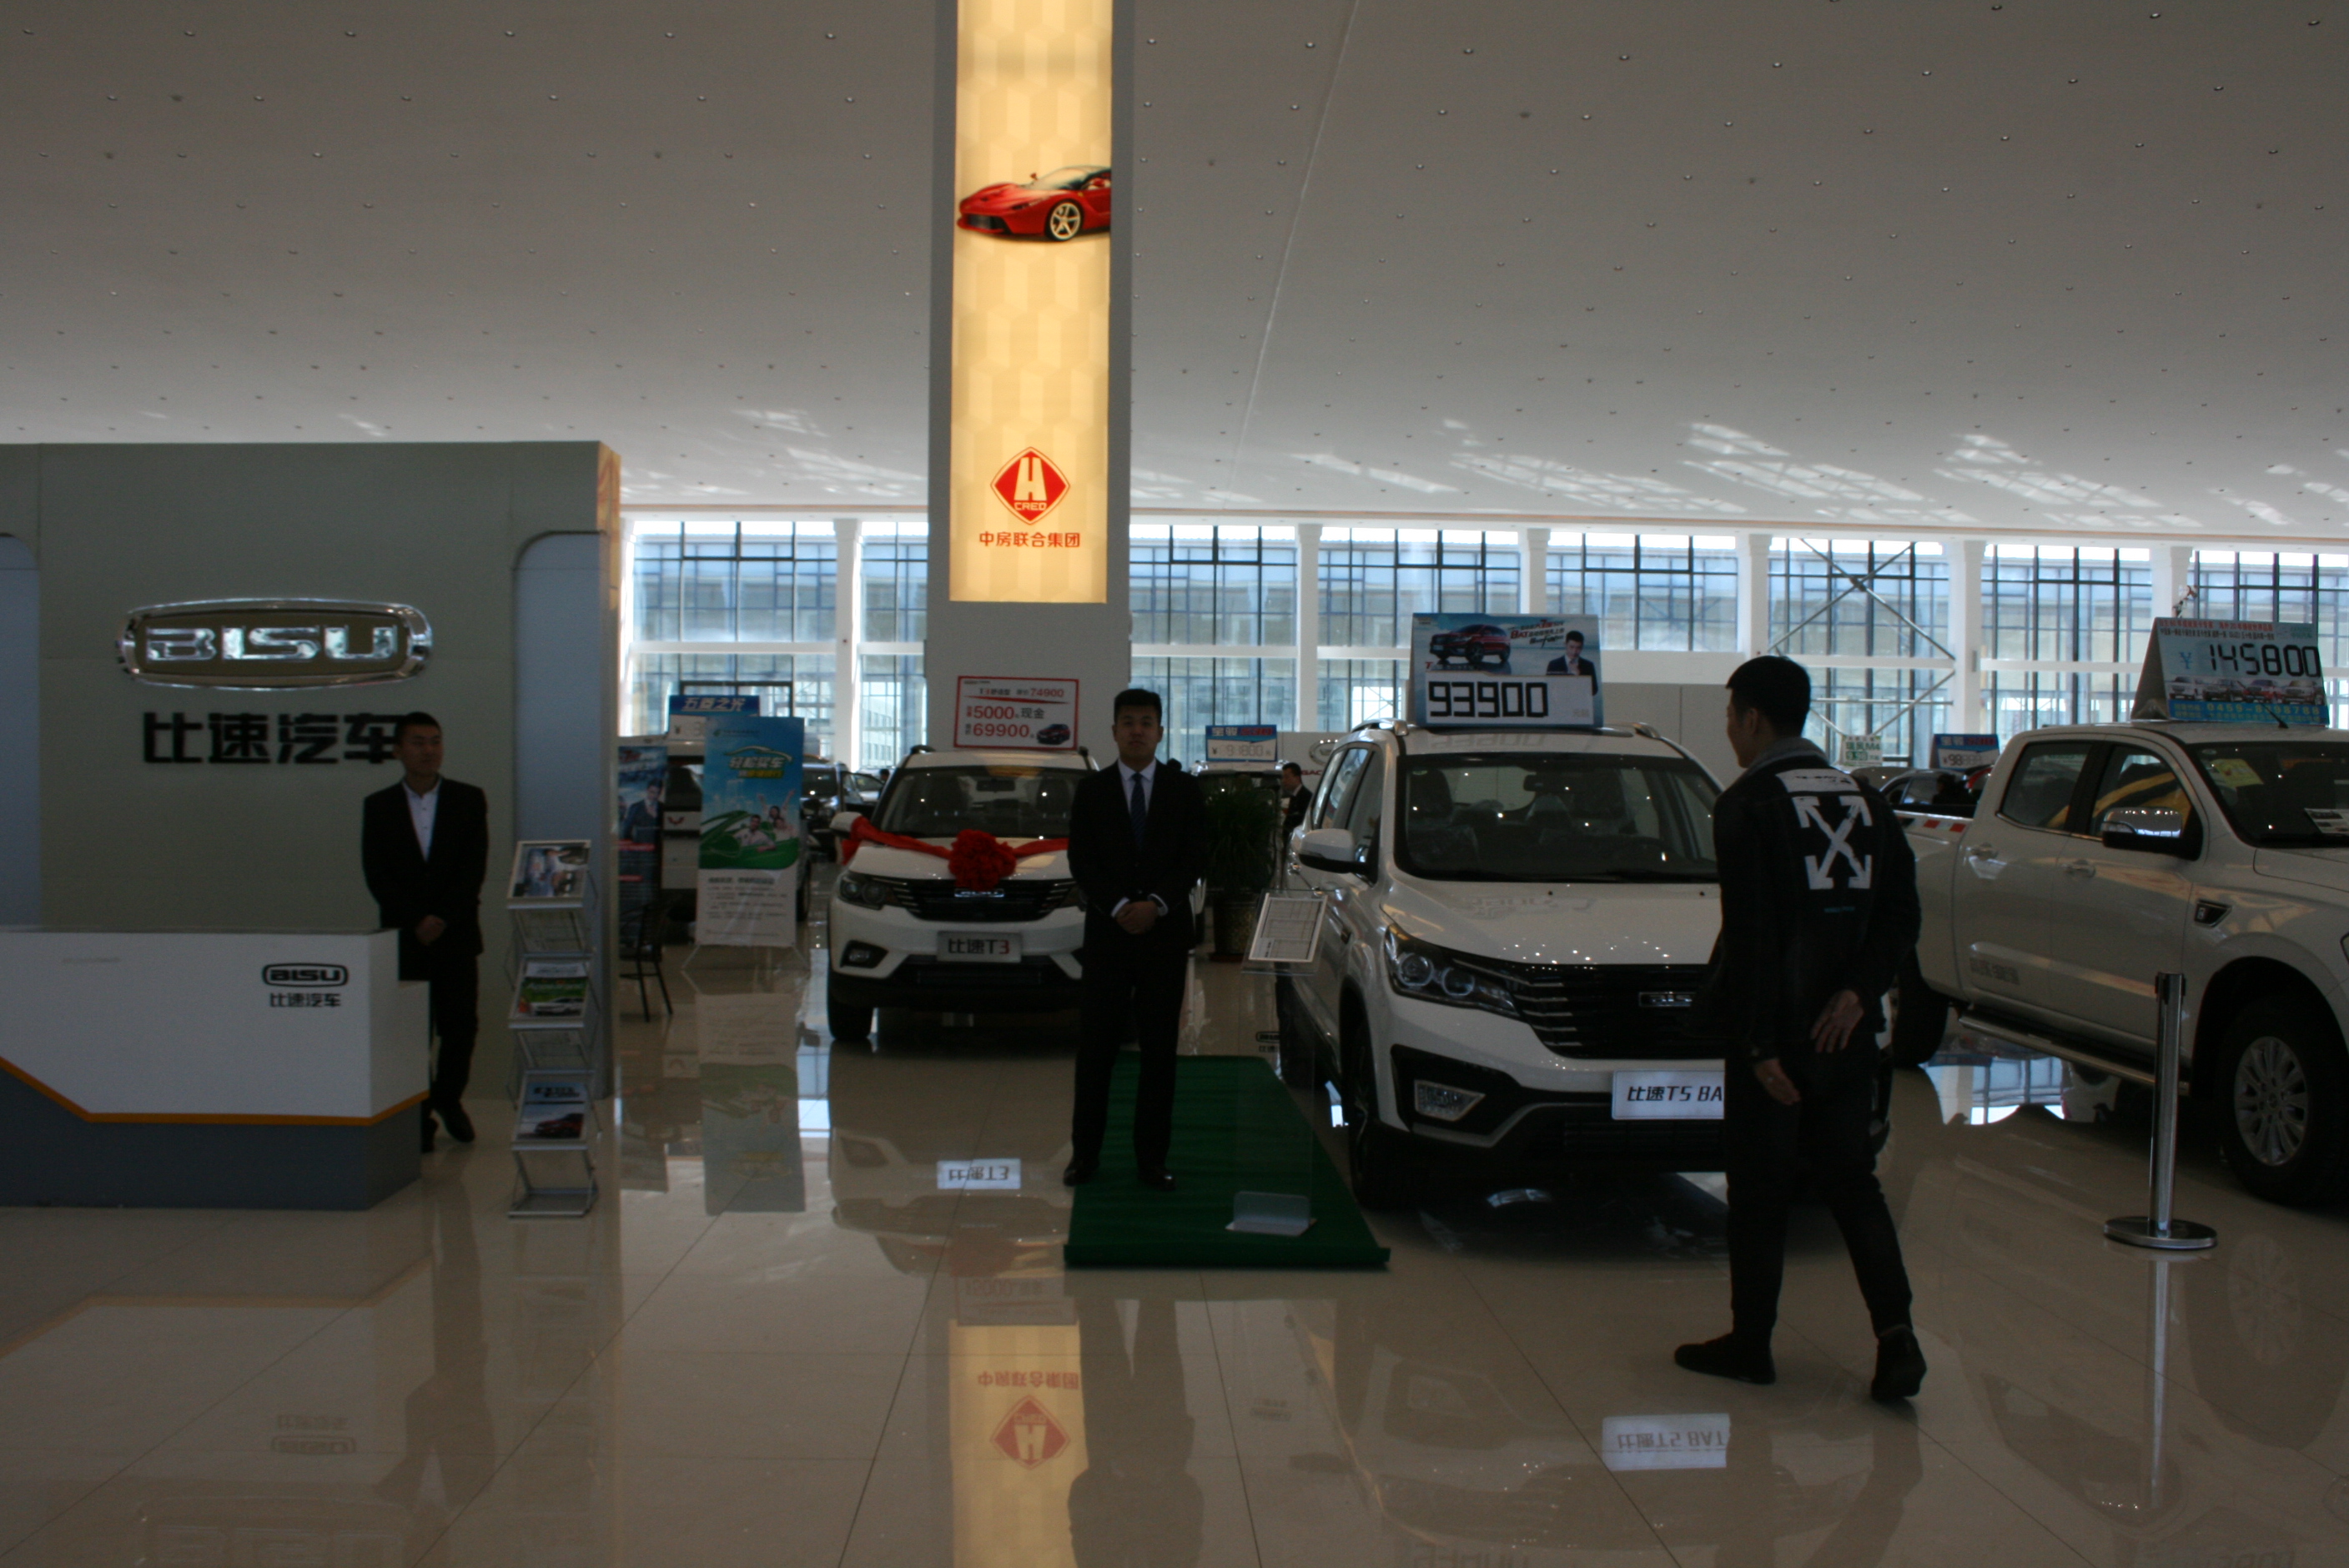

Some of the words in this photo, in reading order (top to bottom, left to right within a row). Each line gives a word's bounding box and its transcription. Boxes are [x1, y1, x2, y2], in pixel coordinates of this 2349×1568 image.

[1014, 502, 1047, 511] CRED
[979, 531, 1081, 548] 中房联合集团
[145, 624, 400, 663] BISU
[2209, 643, 2321, 678] 145800
[1030, 687, 1064, 697] 74900
[1428, 681, 1549, 717] 93900
[143, 711, 405, 765] 比速汽车
[948, 938, 1010, 955] 比速T3
[269, 969, 341, 982] BISU
[269, 993, 342, 1008] 比速汽车
[1697, 1086, 1723, 1102] 8A
